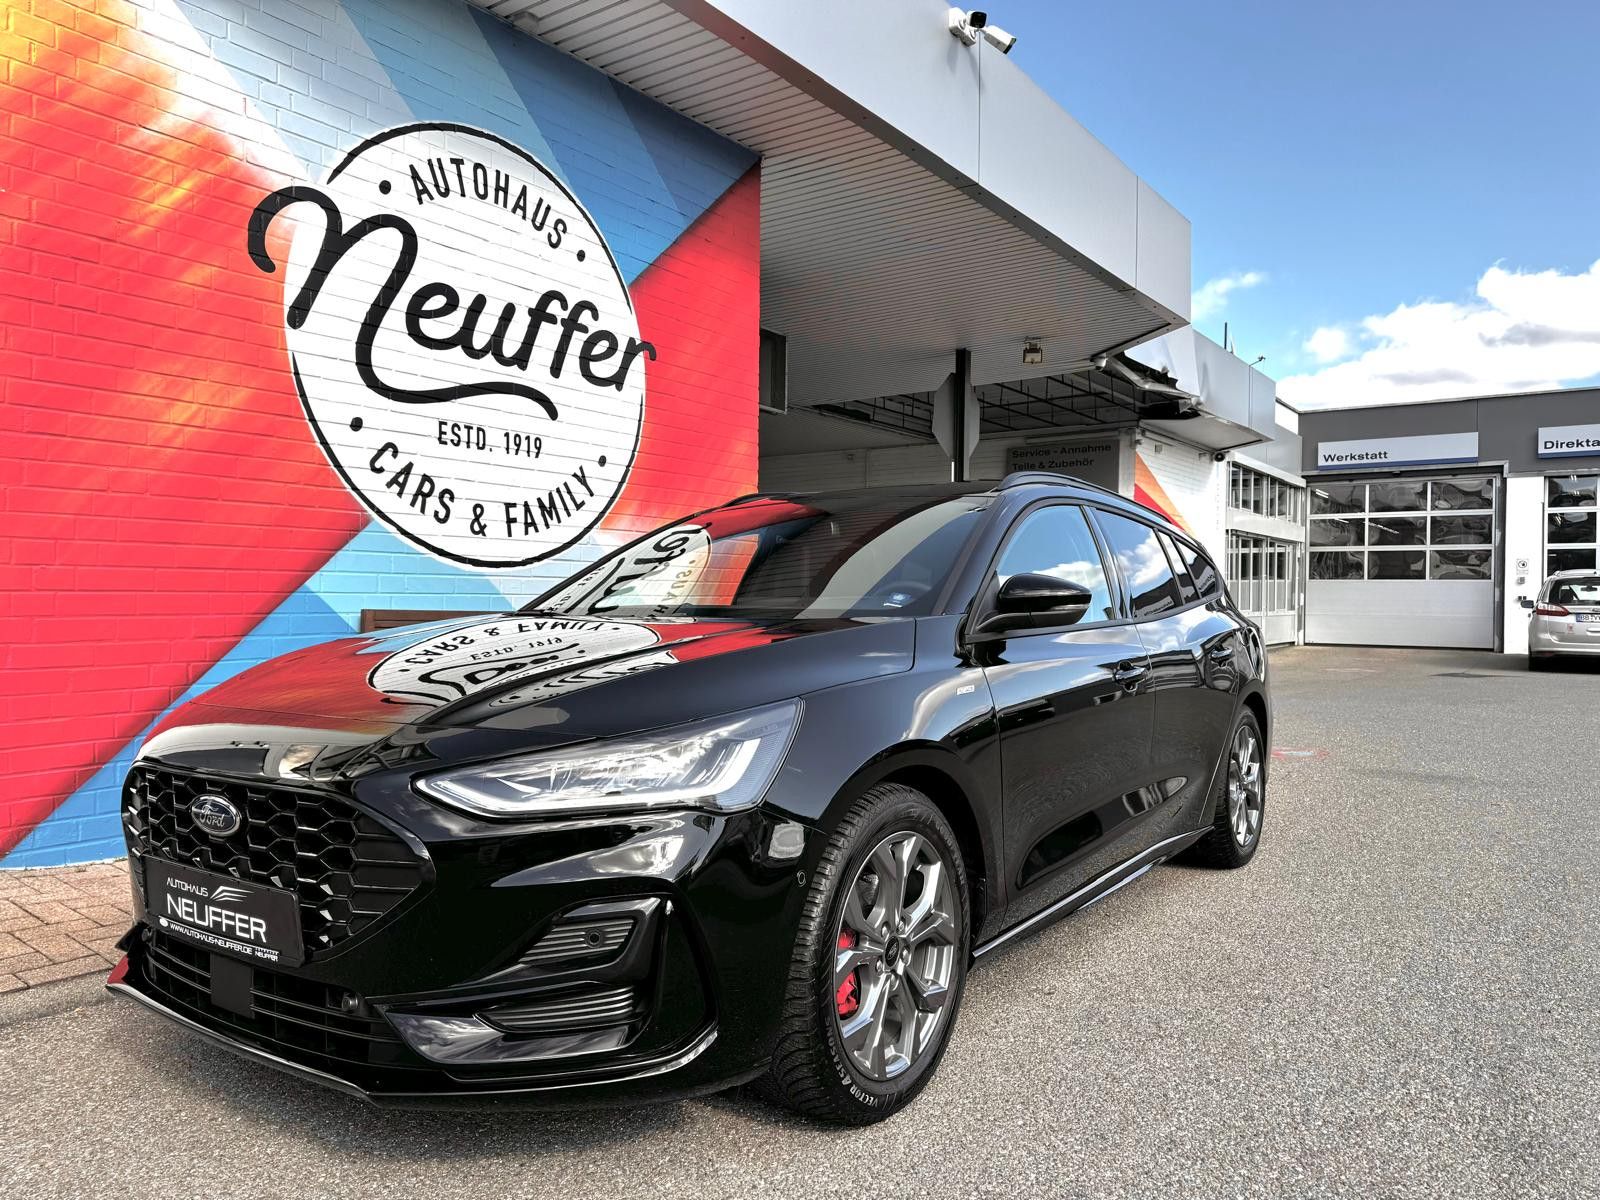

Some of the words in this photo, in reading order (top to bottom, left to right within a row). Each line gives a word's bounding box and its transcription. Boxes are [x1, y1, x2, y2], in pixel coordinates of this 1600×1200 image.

[408, 158, 567, 249] AUTOHAUS
[247, 185, 656, 421] Neuffer
[437, 420, 493, 452] ESTD.
[503, 432, 542, 459] 1919
[1012, 448, 1050, 459] Service
[1061, 444, 1111, 455] Annahme
[1012, 462, 1036, 471] Teile
[1048, 457, 1095, 469] Zubehör
[1323, 450, 1388, 463] Werkstatt
[369, 442, 455, 524] CARS
[469, 503, 488, 537] &
[505, 465, 595, 538] FAMILY
[200, 804, 225, 828] Ford
[166, 877, 209, 898] AUTOHAUS
[166, 893, 267, 943] NEUFFER
[849, 1084, 878, 1107] VECTOR
